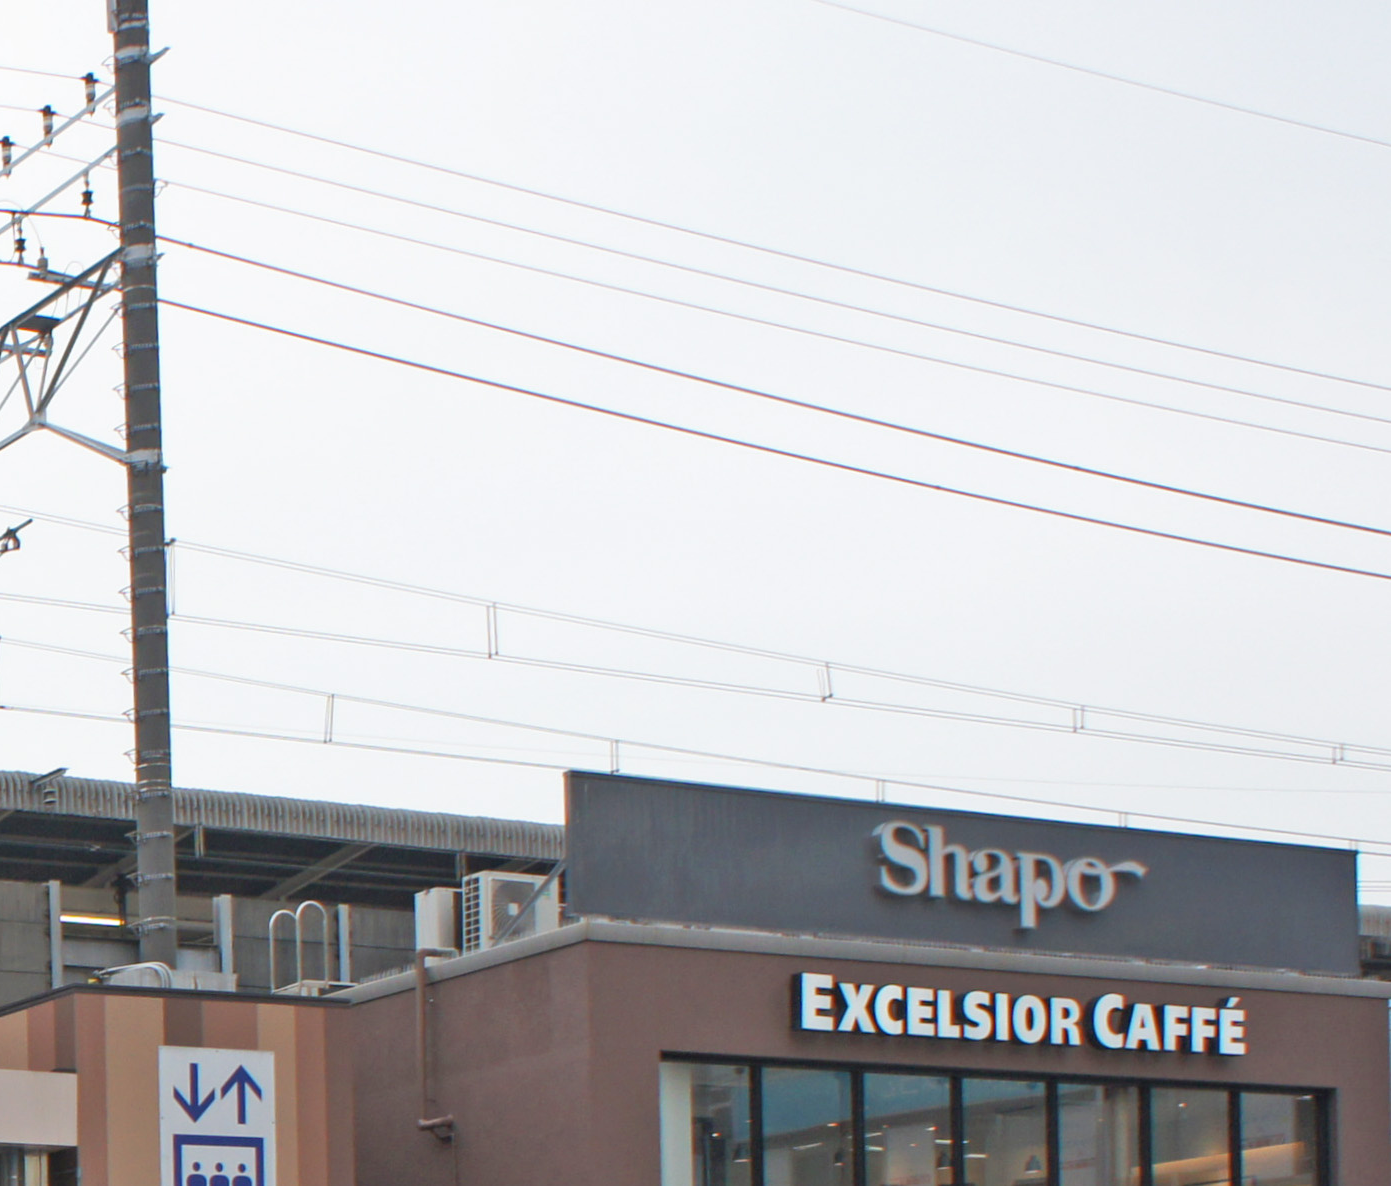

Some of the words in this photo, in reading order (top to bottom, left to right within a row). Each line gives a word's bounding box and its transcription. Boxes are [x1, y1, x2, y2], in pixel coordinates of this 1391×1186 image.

[873, 820, 1149, 929] Shapo
[798, 971, 1083, 1047] EXCELSIOR
[1092, 993, 1248, 1056] CAFFÉ
